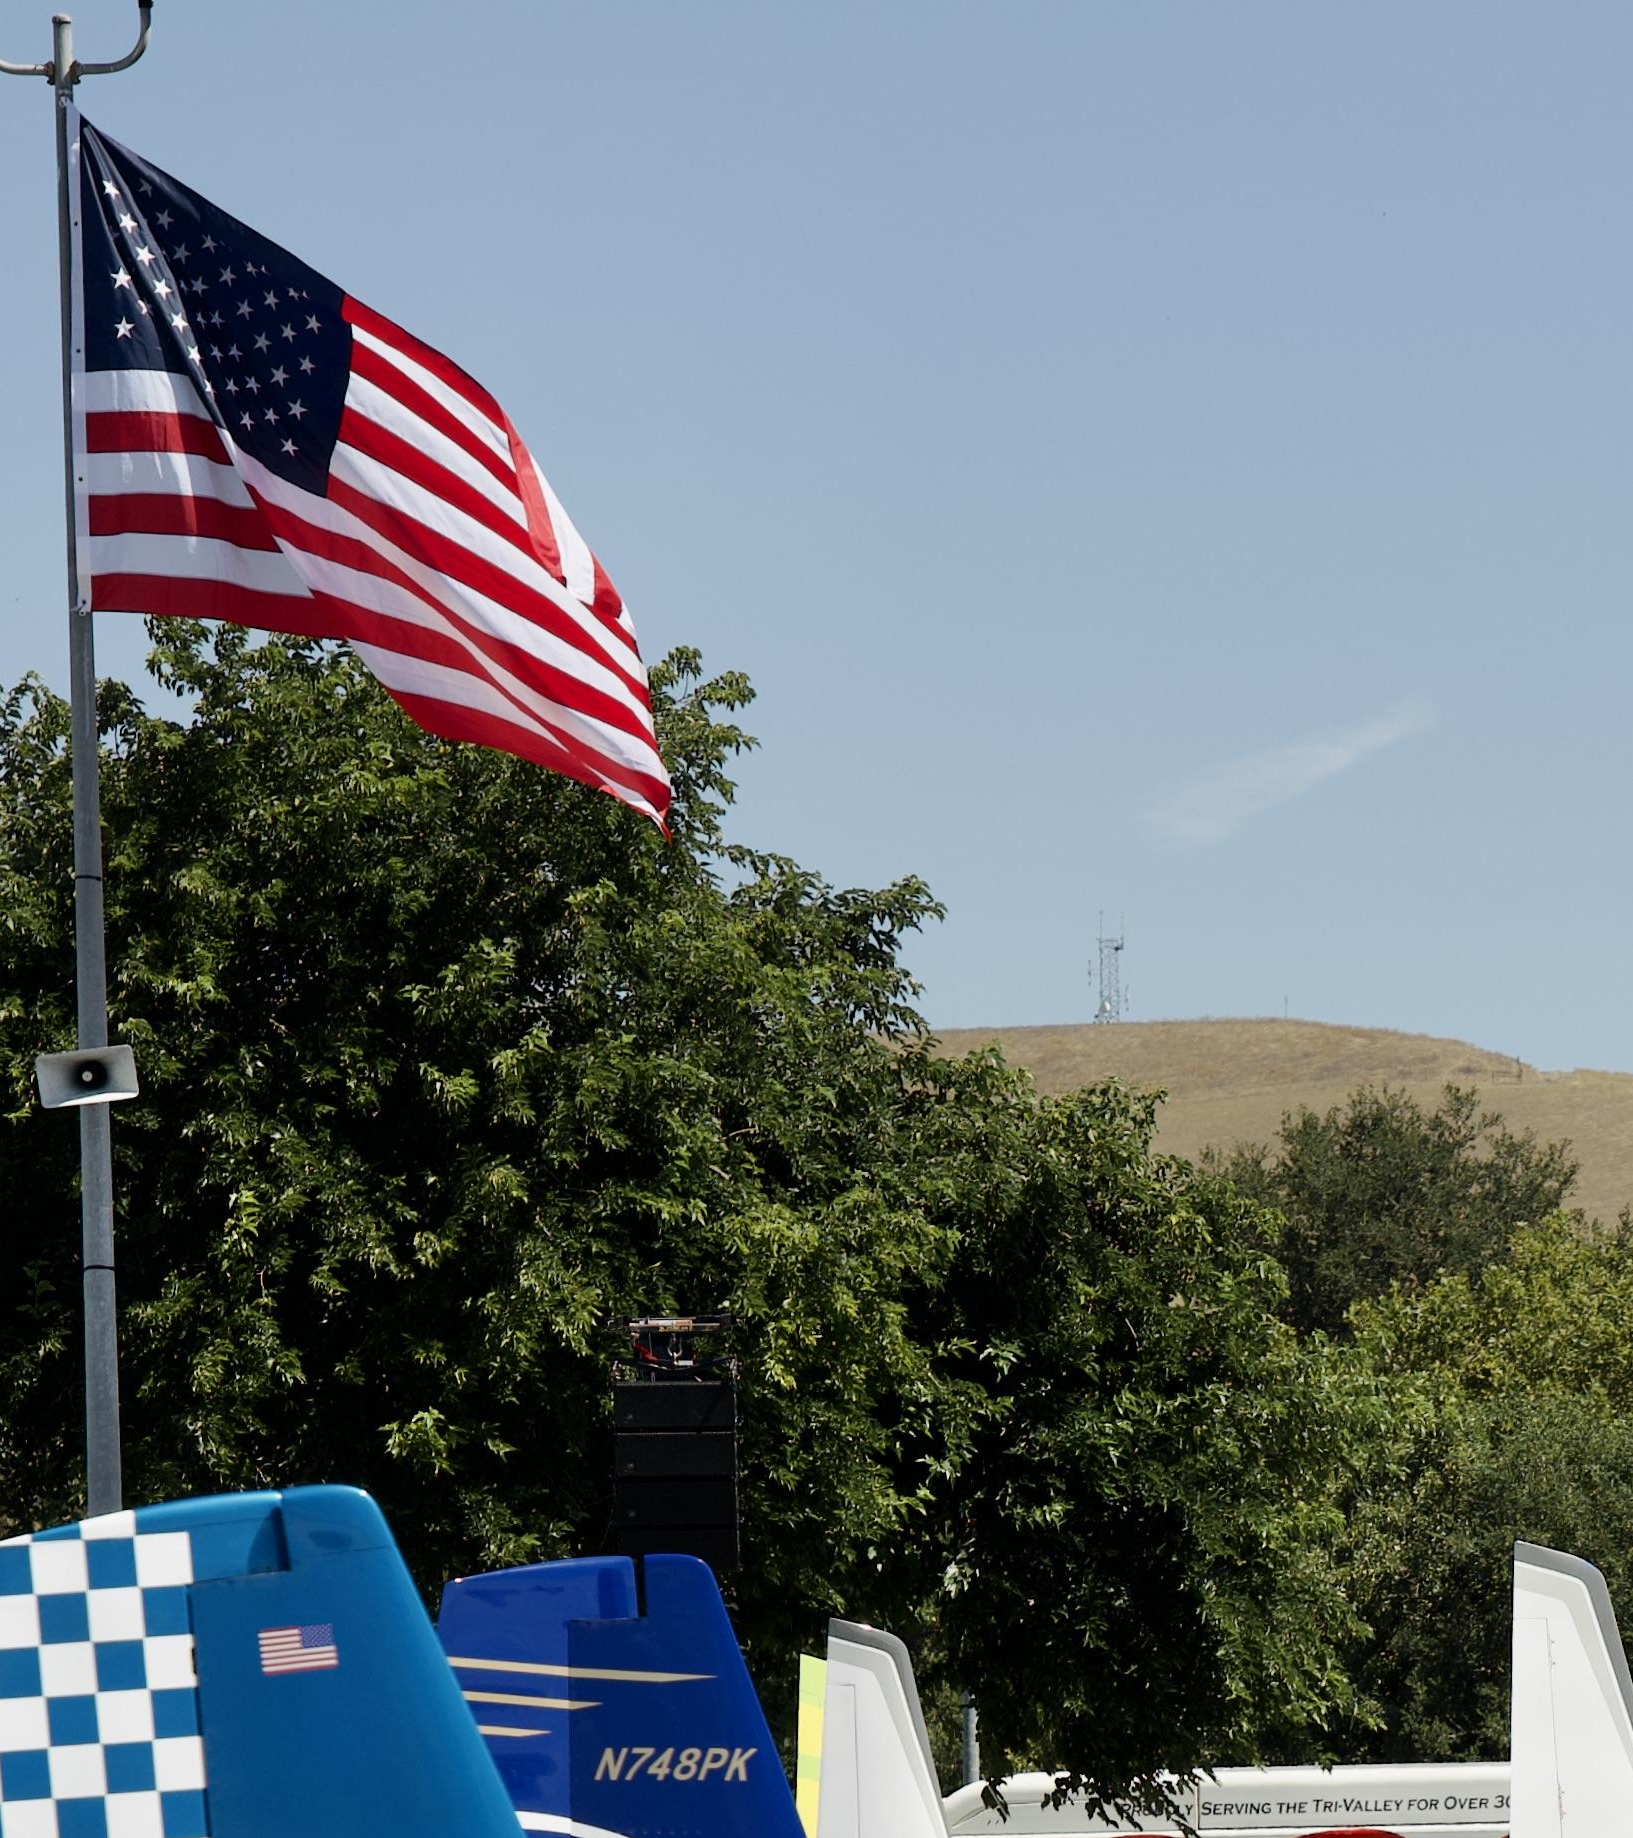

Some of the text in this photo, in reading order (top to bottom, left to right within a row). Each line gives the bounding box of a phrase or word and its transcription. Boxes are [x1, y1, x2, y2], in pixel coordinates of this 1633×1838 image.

[594, 1747, 757, 1781] N748PK
[1201, 1801, 1272, 1816] SERVING
[1276, 1801, 1308, 1814] THE
[1407, 1798, 1440, 1811] FOR
[1444, 1795, 1489, 1810] OVER
